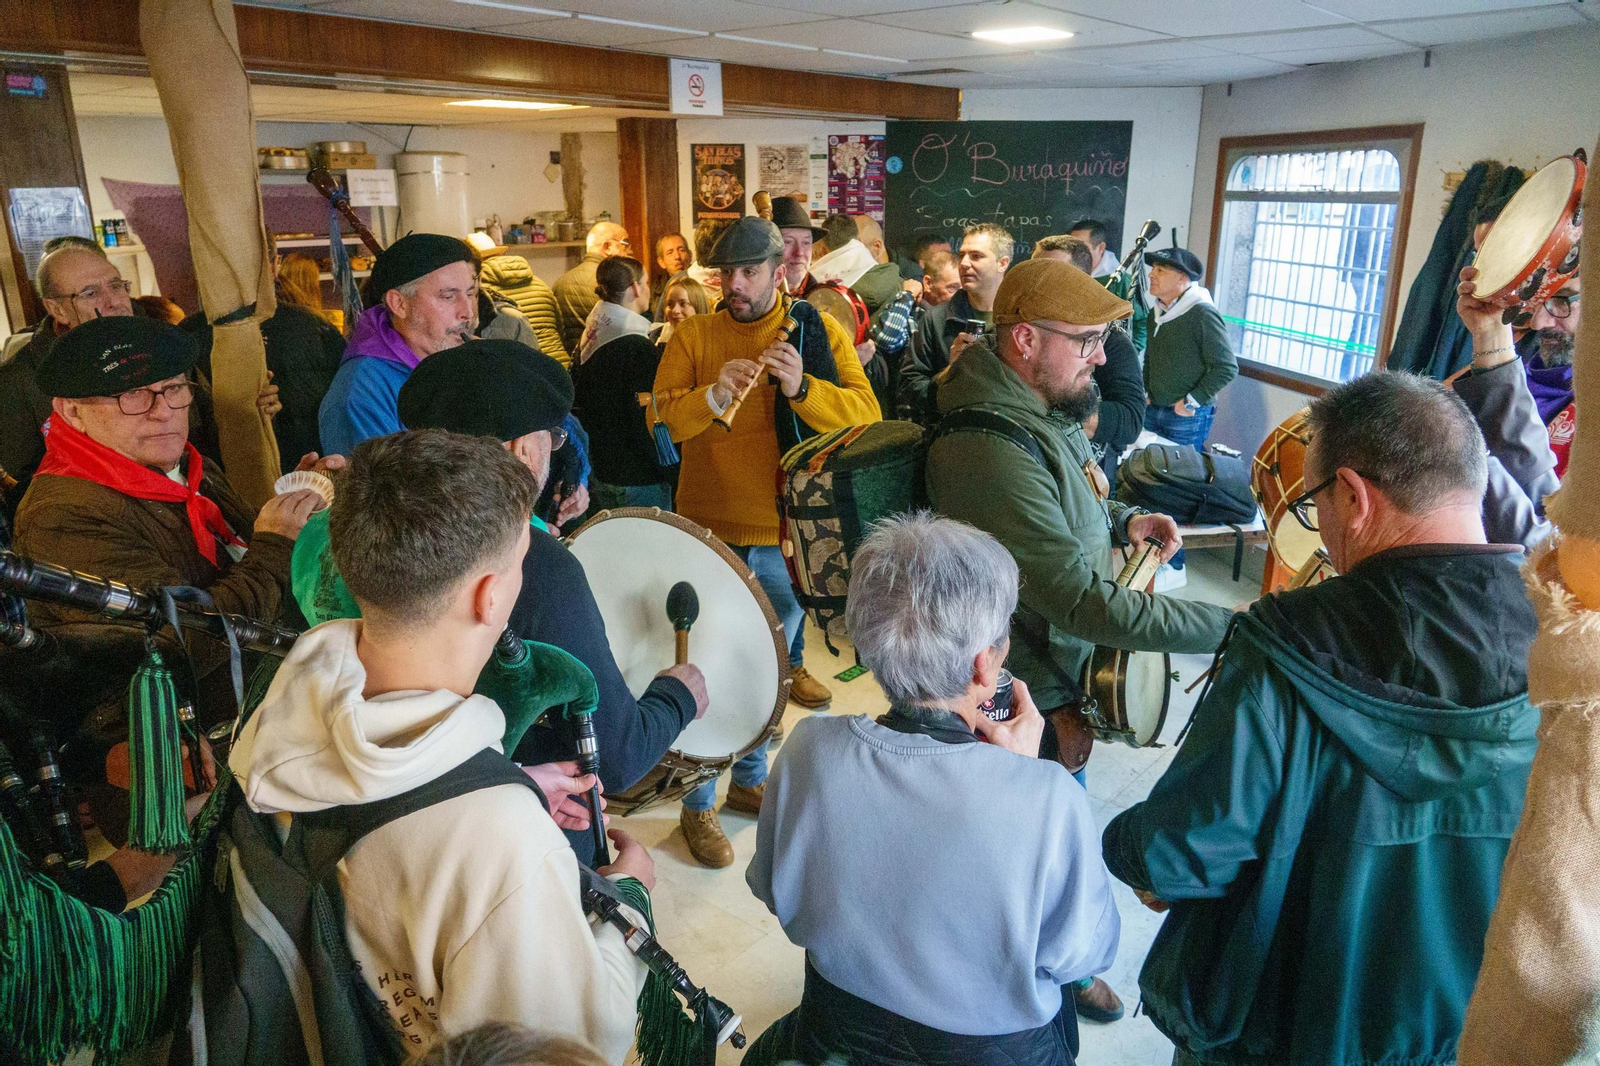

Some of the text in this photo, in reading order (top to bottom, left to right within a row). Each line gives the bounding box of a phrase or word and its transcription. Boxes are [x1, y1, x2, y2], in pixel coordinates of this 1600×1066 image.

[694, 146, 741, 158] SAN BLAS
[702, 156, 735, 165] THINGS
[102, 361, 119, 373] TRES
[980, 708, 1010, 721] rella
